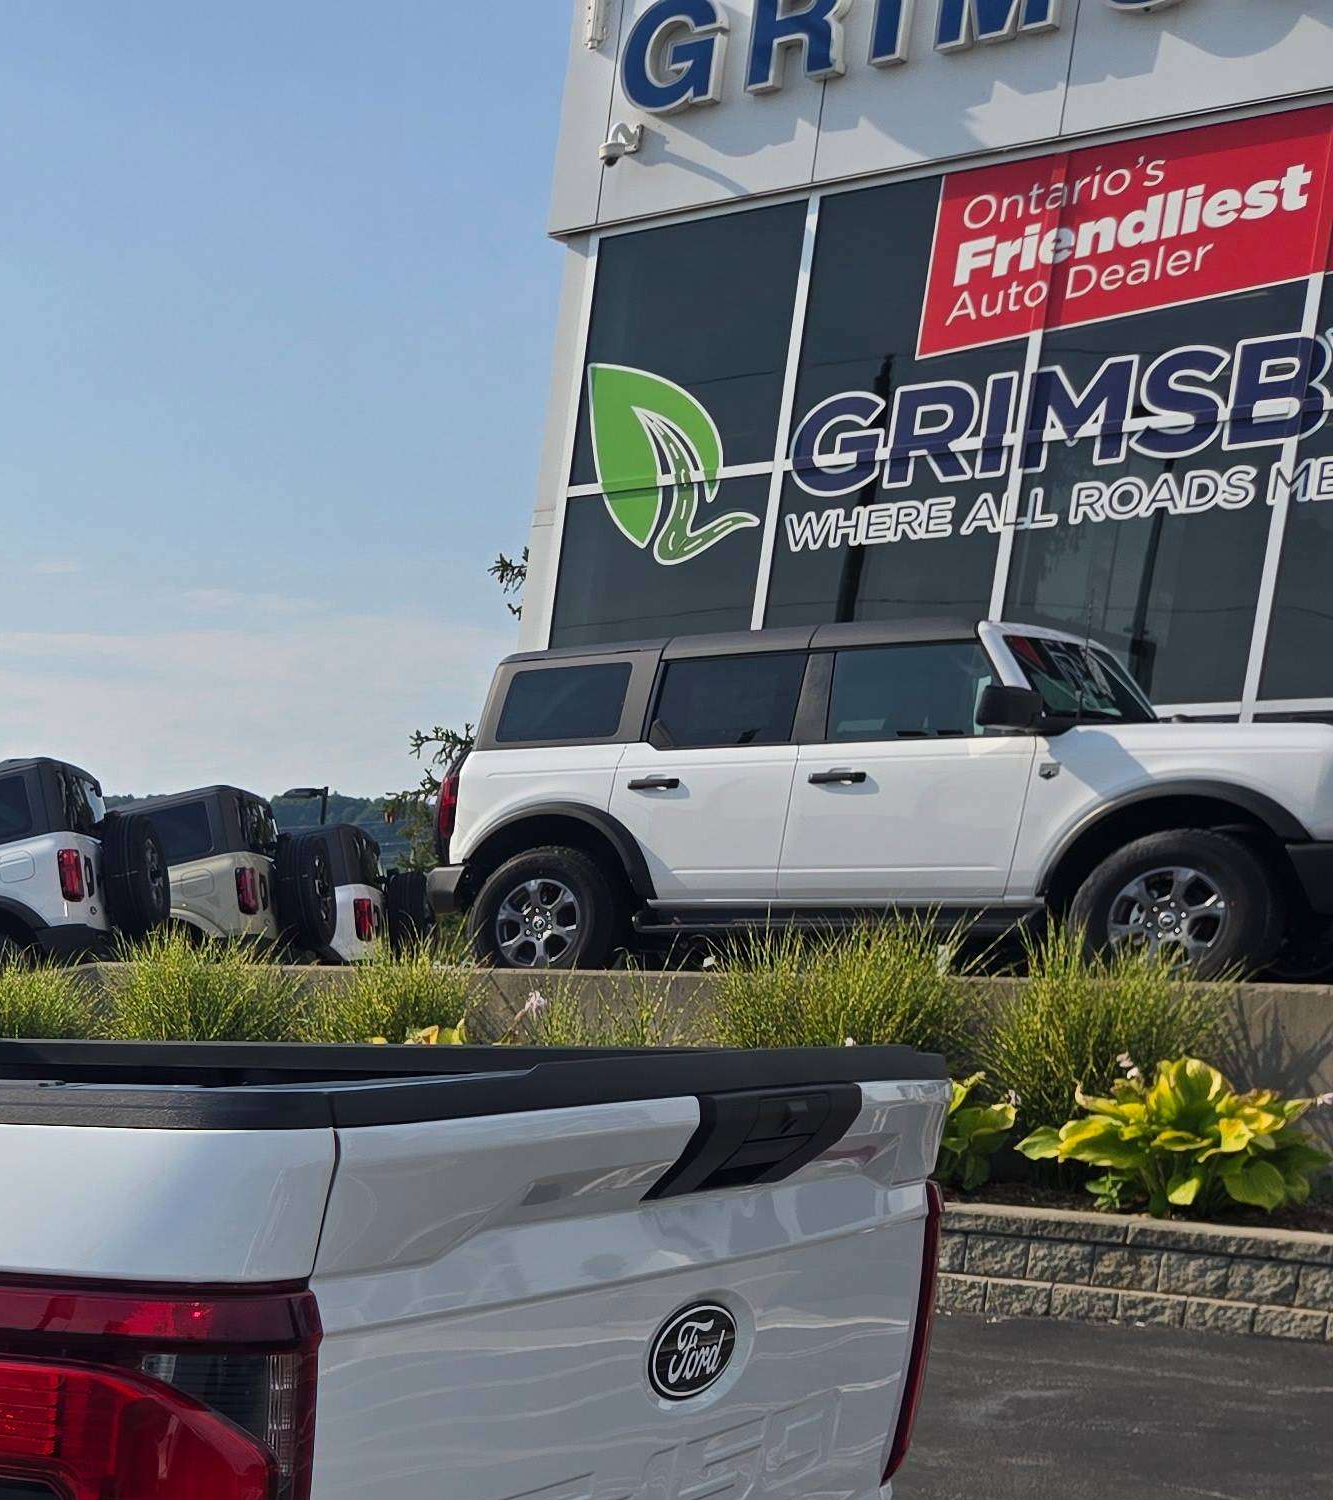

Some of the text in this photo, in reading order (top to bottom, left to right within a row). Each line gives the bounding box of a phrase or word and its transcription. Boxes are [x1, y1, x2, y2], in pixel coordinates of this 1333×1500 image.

[953, 163, 1313, 288] Friendliest
[963, 156, 1166, 230] Ontario's
[945, 243, 1214, 326] Auto Dealer
[790, 326, 1333, 498] GRIMSB
[785, 496, 956, 552] WHERE
[960, 487, 1058, 536] ALL
[1069, 464, 1257, 526] ROADS
[667, 1318, 726, 1384] Ford
